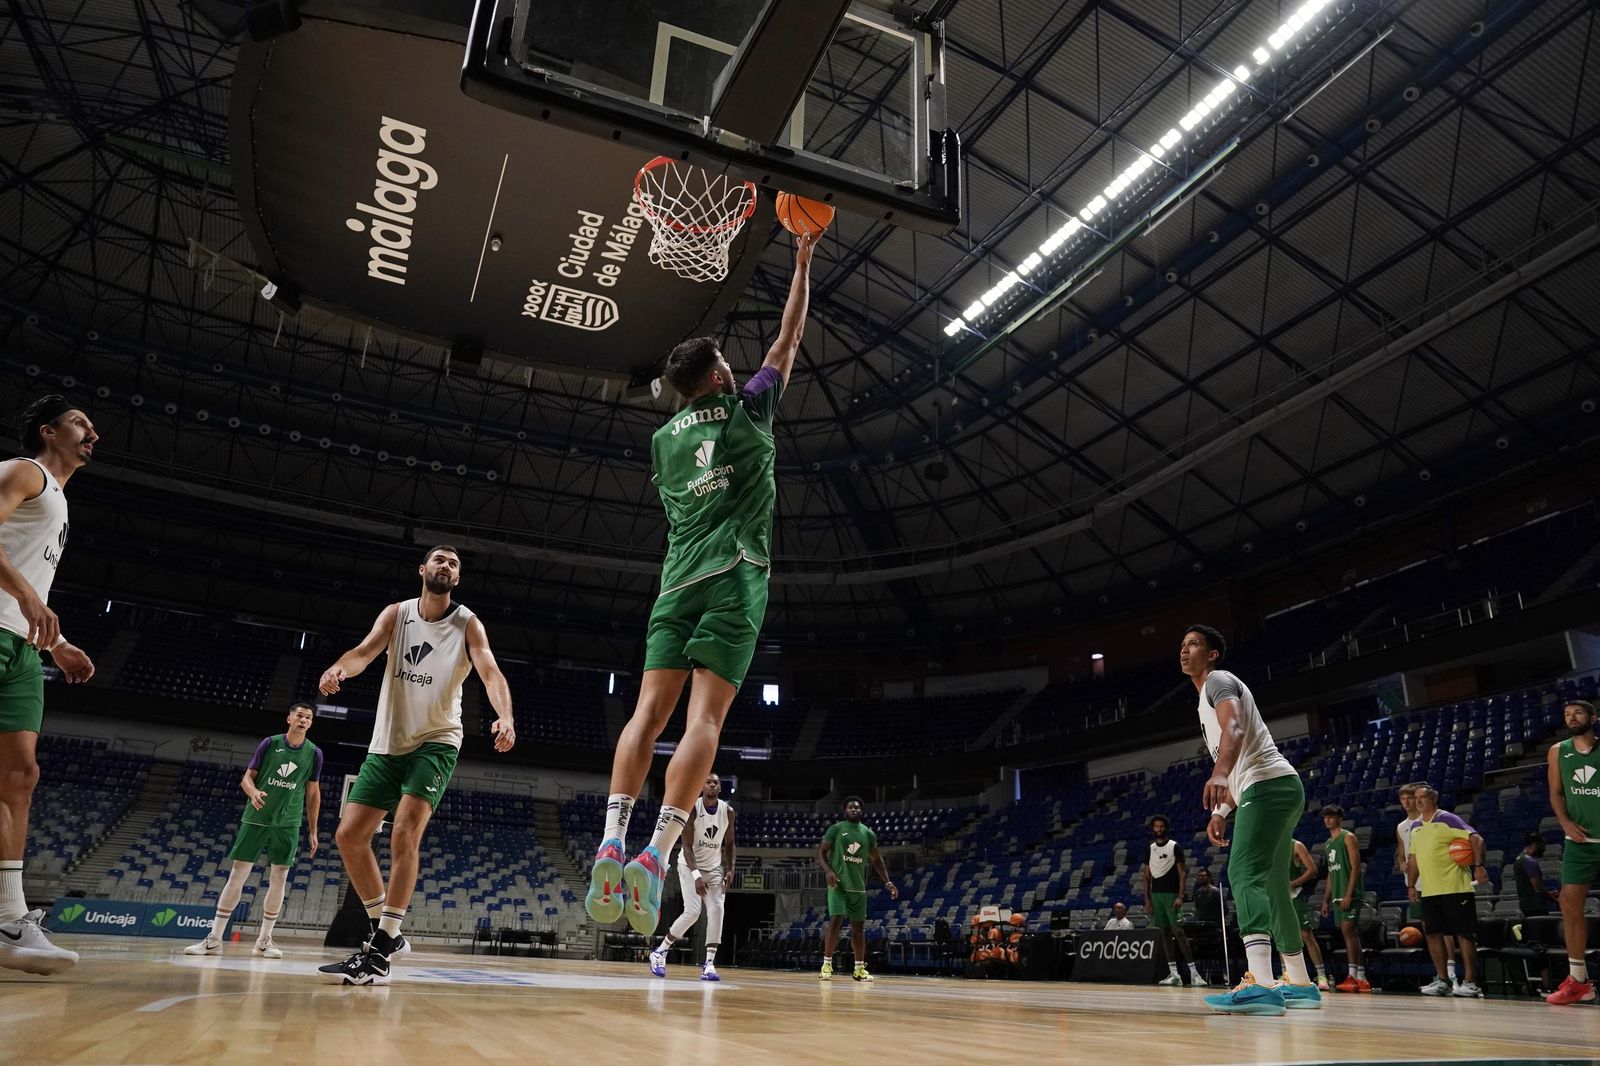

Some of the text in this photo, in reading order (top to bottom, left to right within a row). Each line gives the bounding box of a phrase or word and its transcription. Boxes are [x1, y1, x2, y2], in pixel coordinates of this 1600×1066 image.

[557, 209, 604, 278] Ciudad
[592, 264, 621, 287] de
[694, 476, 730, 497] Unicaja
[268, 777, 297, 790] Unicaja
[1570, 786, 1600, 797] Unicaj
[85, 911, 137, 928] Unicaja
[177, 915, 213, 928] Unica
[1080, 935, 1155, 959] endesa
